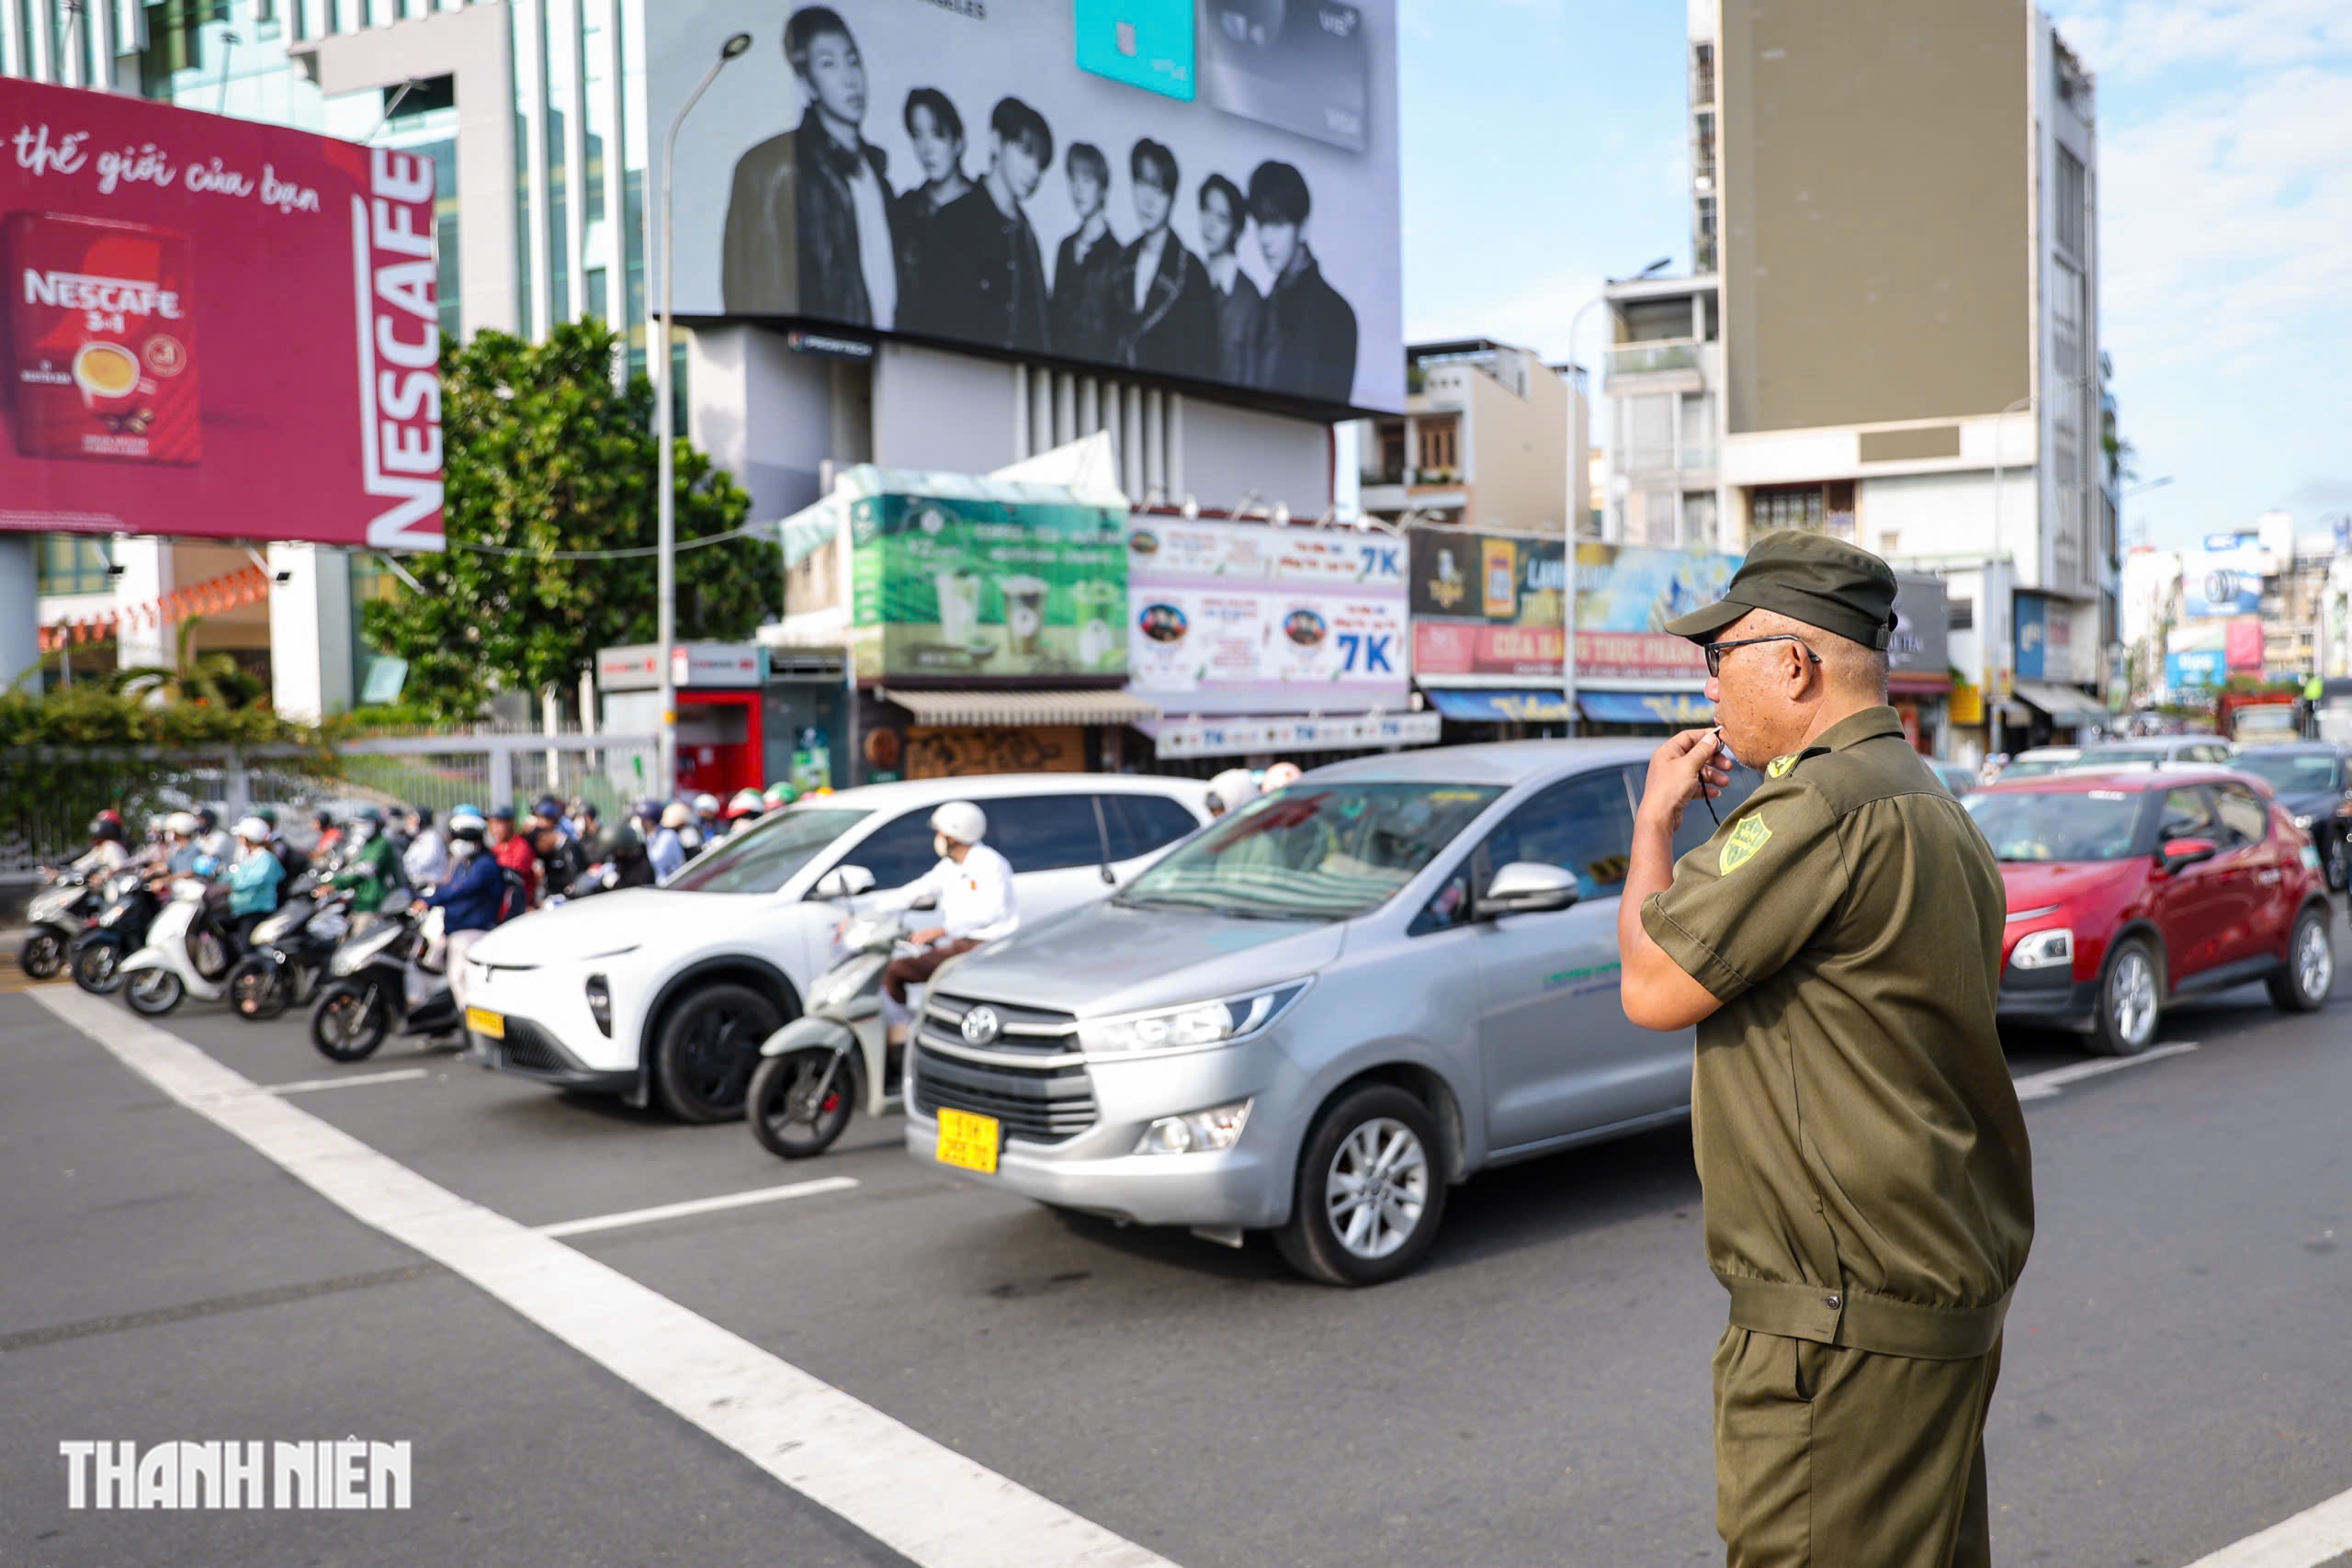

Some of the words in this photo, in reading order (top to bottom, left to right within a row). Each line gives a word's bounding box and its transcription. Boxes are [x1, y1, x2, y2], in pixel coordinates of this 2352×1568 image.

[12, 124, 90, 176] thế
[96, 142, 177, 195] giới
[185, 156, 254, 197] của
[260, 162, 322, 214] bạn
[1361, 546, 1398, 574] 7K
[1338, 635, 1392, 671] 7K
